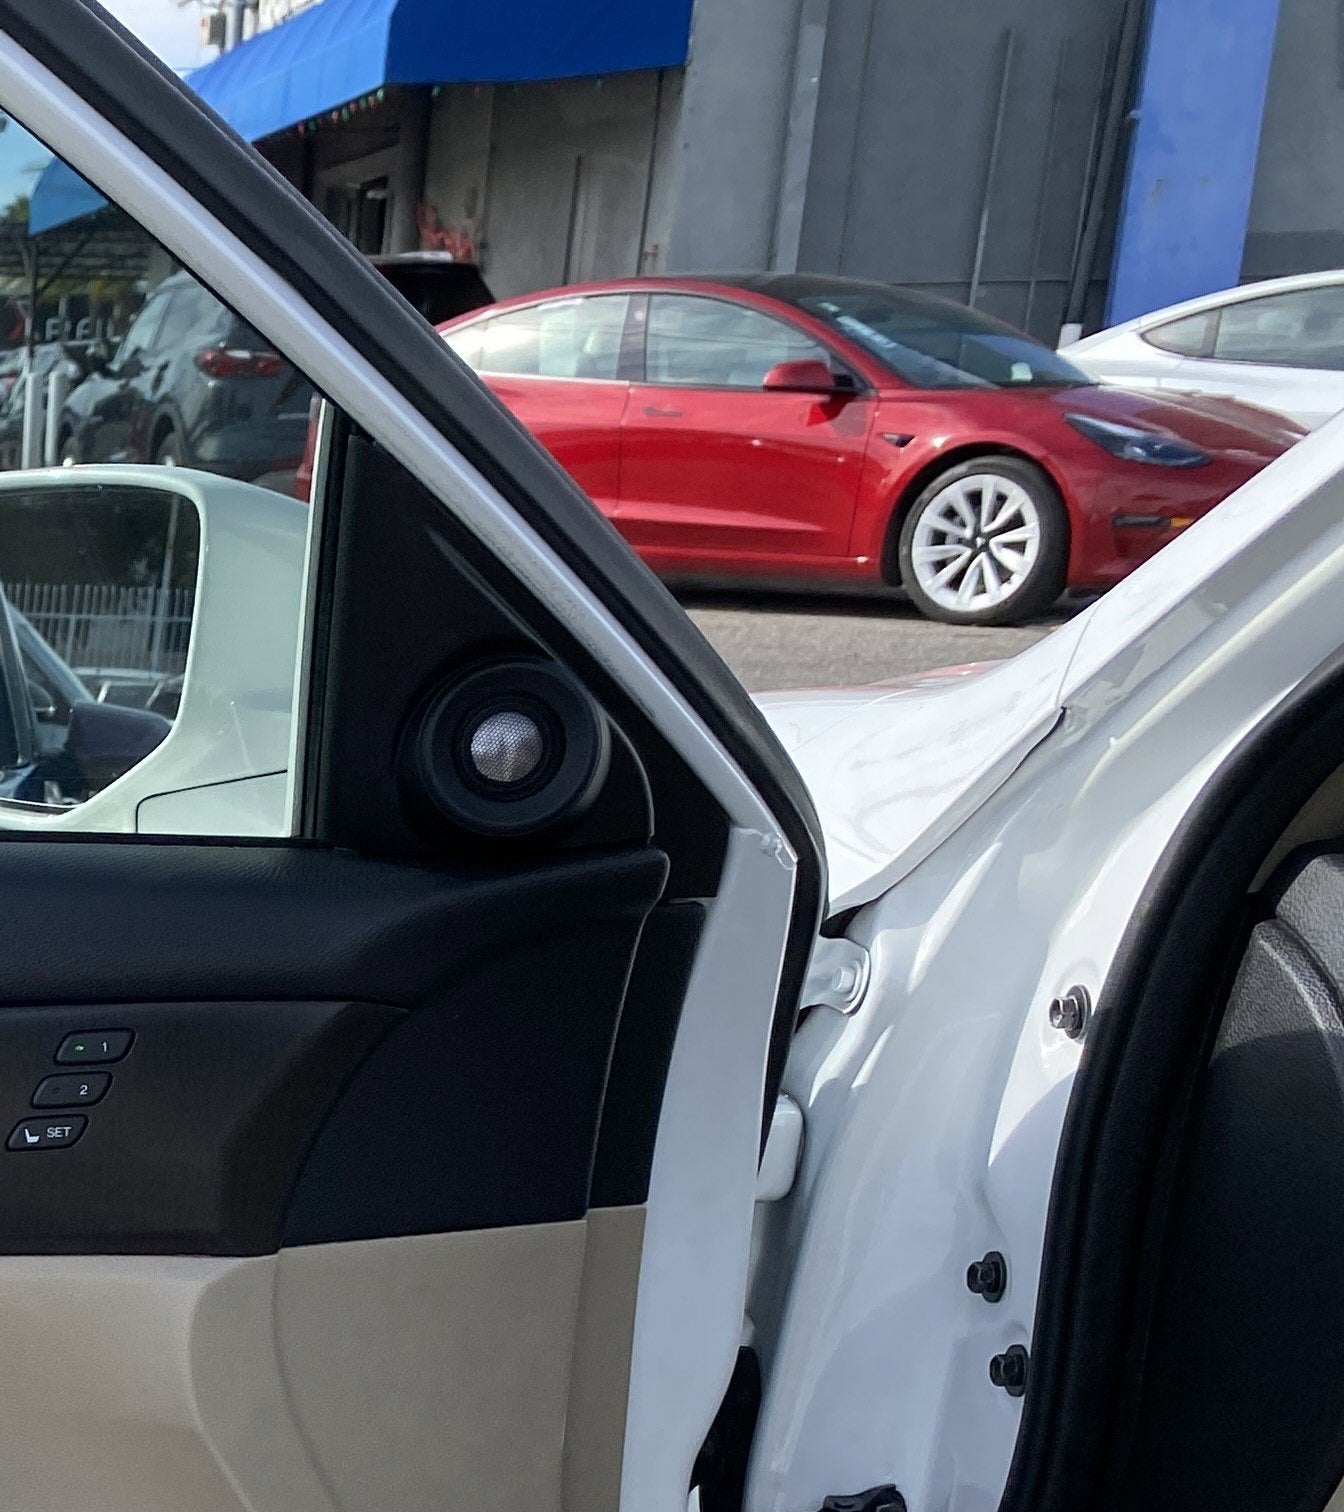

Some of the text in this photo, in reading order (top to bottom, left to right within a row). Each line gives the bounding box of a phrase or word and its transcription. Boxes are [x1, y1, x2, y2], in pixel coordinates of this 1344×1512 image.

[102, 1042, 108, 1052] 1
[79, 1084, 88, 1096] 2
[46, 1126, 72, 1139] SET
